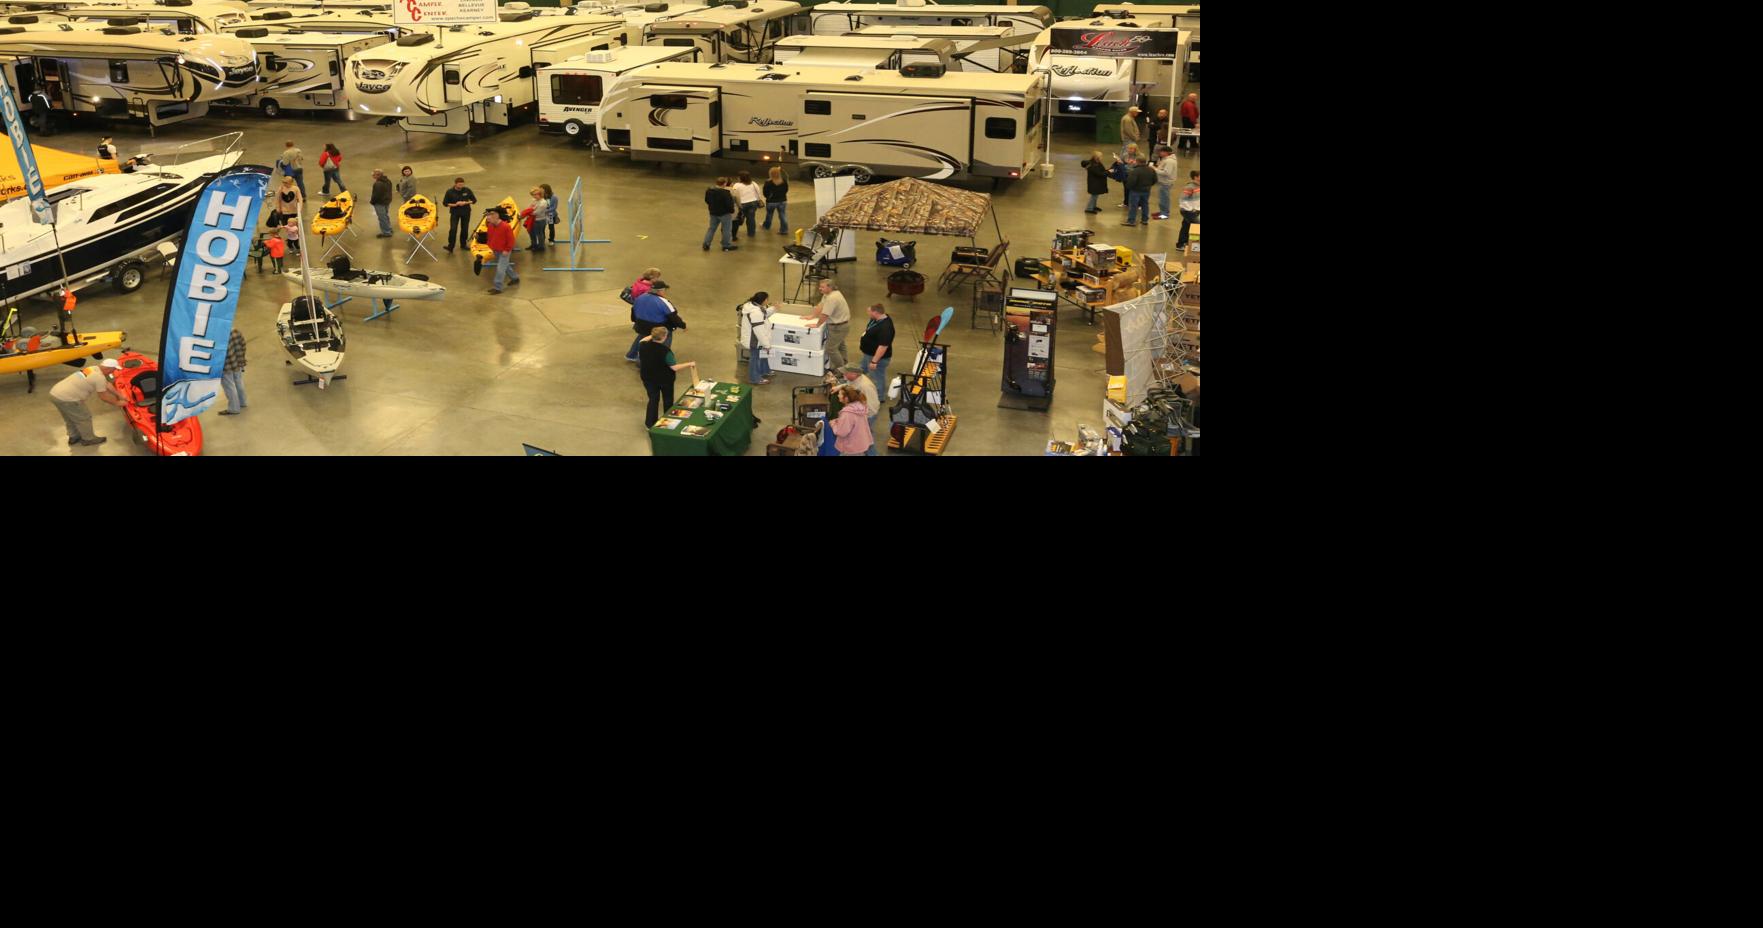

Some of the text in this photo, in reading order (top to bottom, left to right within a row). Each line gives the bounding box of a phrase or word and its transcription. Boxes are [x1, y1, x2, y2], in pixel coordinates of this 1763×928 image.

[1051, 65, 1113, 77] Reflection
[358, 82, 391, 91] Jayco
[179, 190, 252, 374] HOBIE
